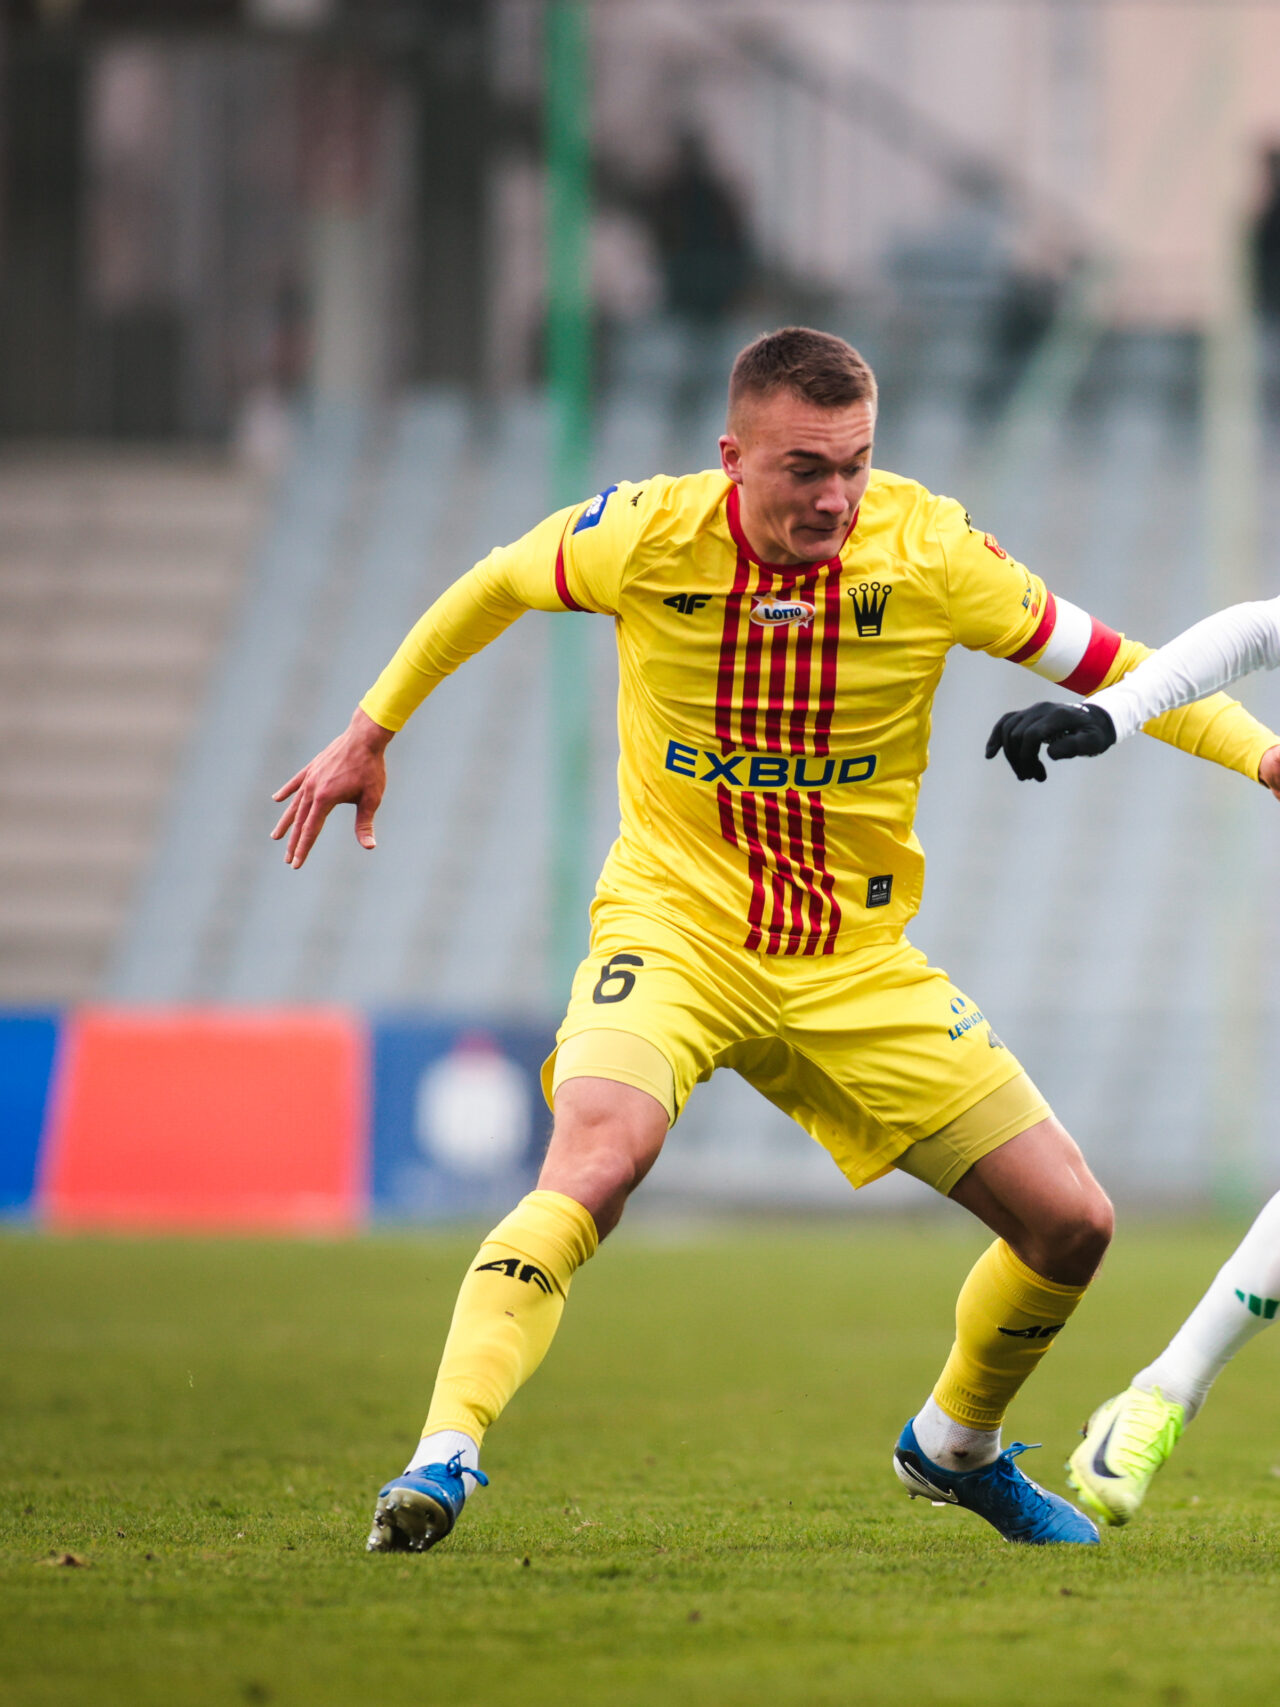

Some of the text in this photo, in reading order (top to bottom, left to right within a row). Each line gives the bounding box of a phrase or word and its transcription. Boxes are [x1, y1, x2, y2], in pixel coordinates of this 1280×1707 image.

[662, 593, 712, 614] 4F
[764, 606, 802, 620] LOTTO
[665, 739, 876, 787] EXBUD
[593, 953, 644, 1004] 6
